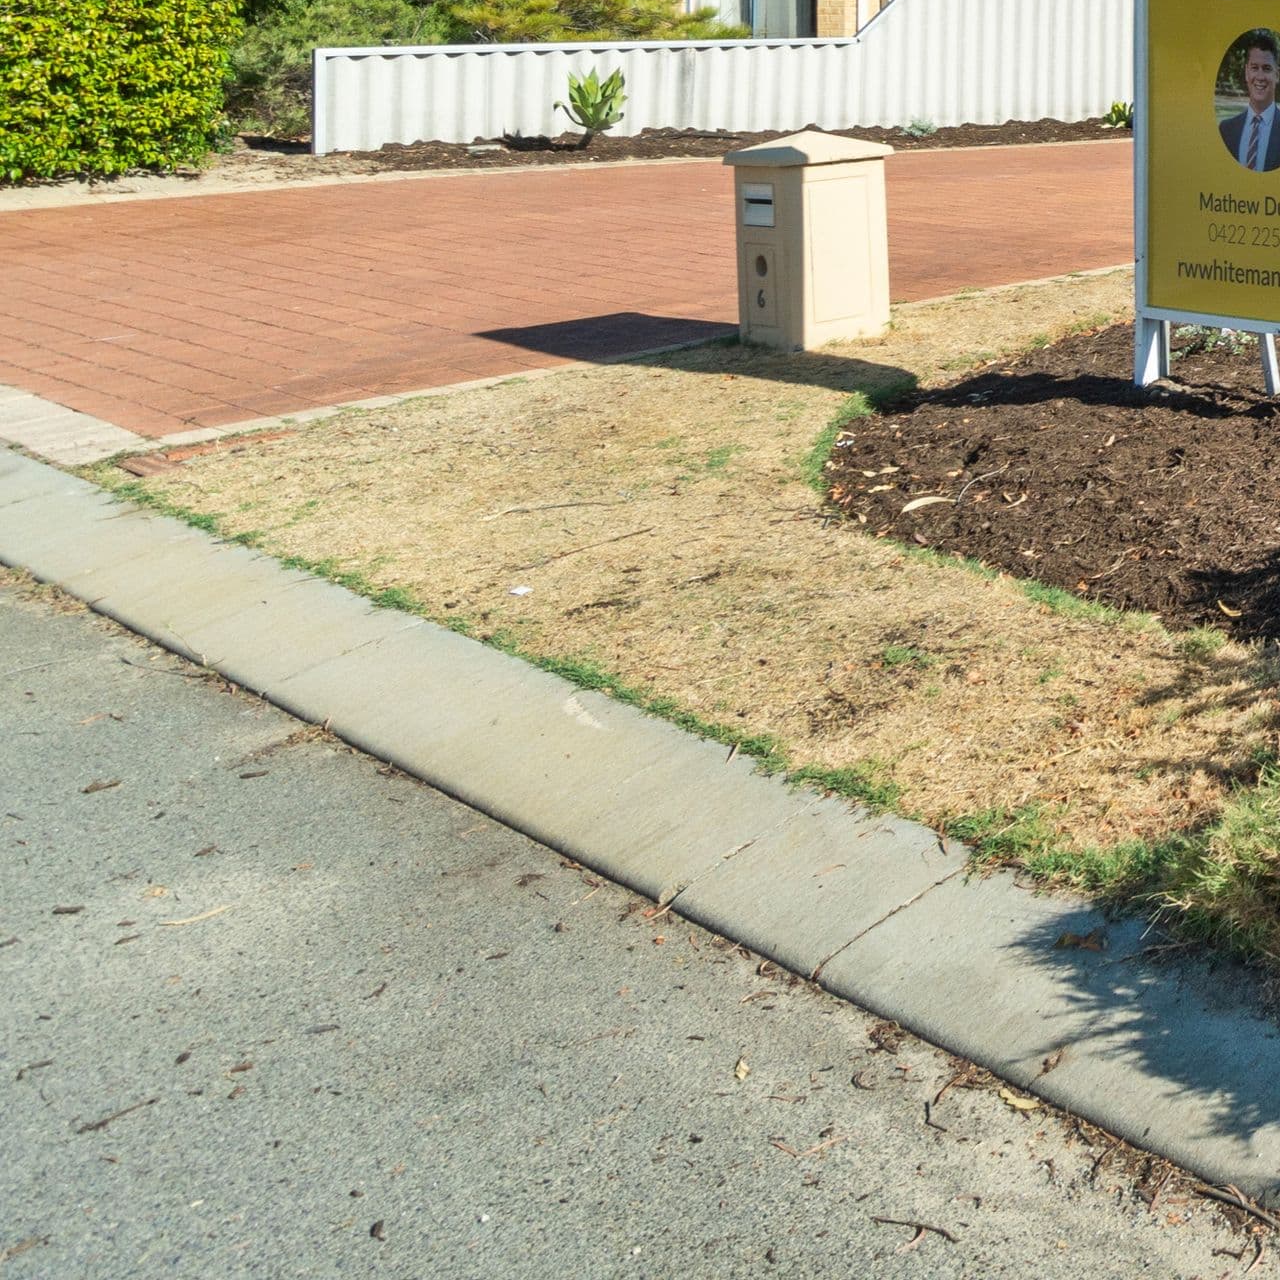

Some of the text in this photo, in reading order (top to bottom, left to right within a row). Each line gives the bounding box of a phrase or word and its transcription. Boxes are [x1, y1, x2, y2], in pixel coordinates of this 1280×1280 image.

[1199, 192, 1260, 216] Mathew
[1208, 222, 1246, 245] 0422
[1251, 226, 1280, 248] 225
[757, 289, 766, 309] 6
